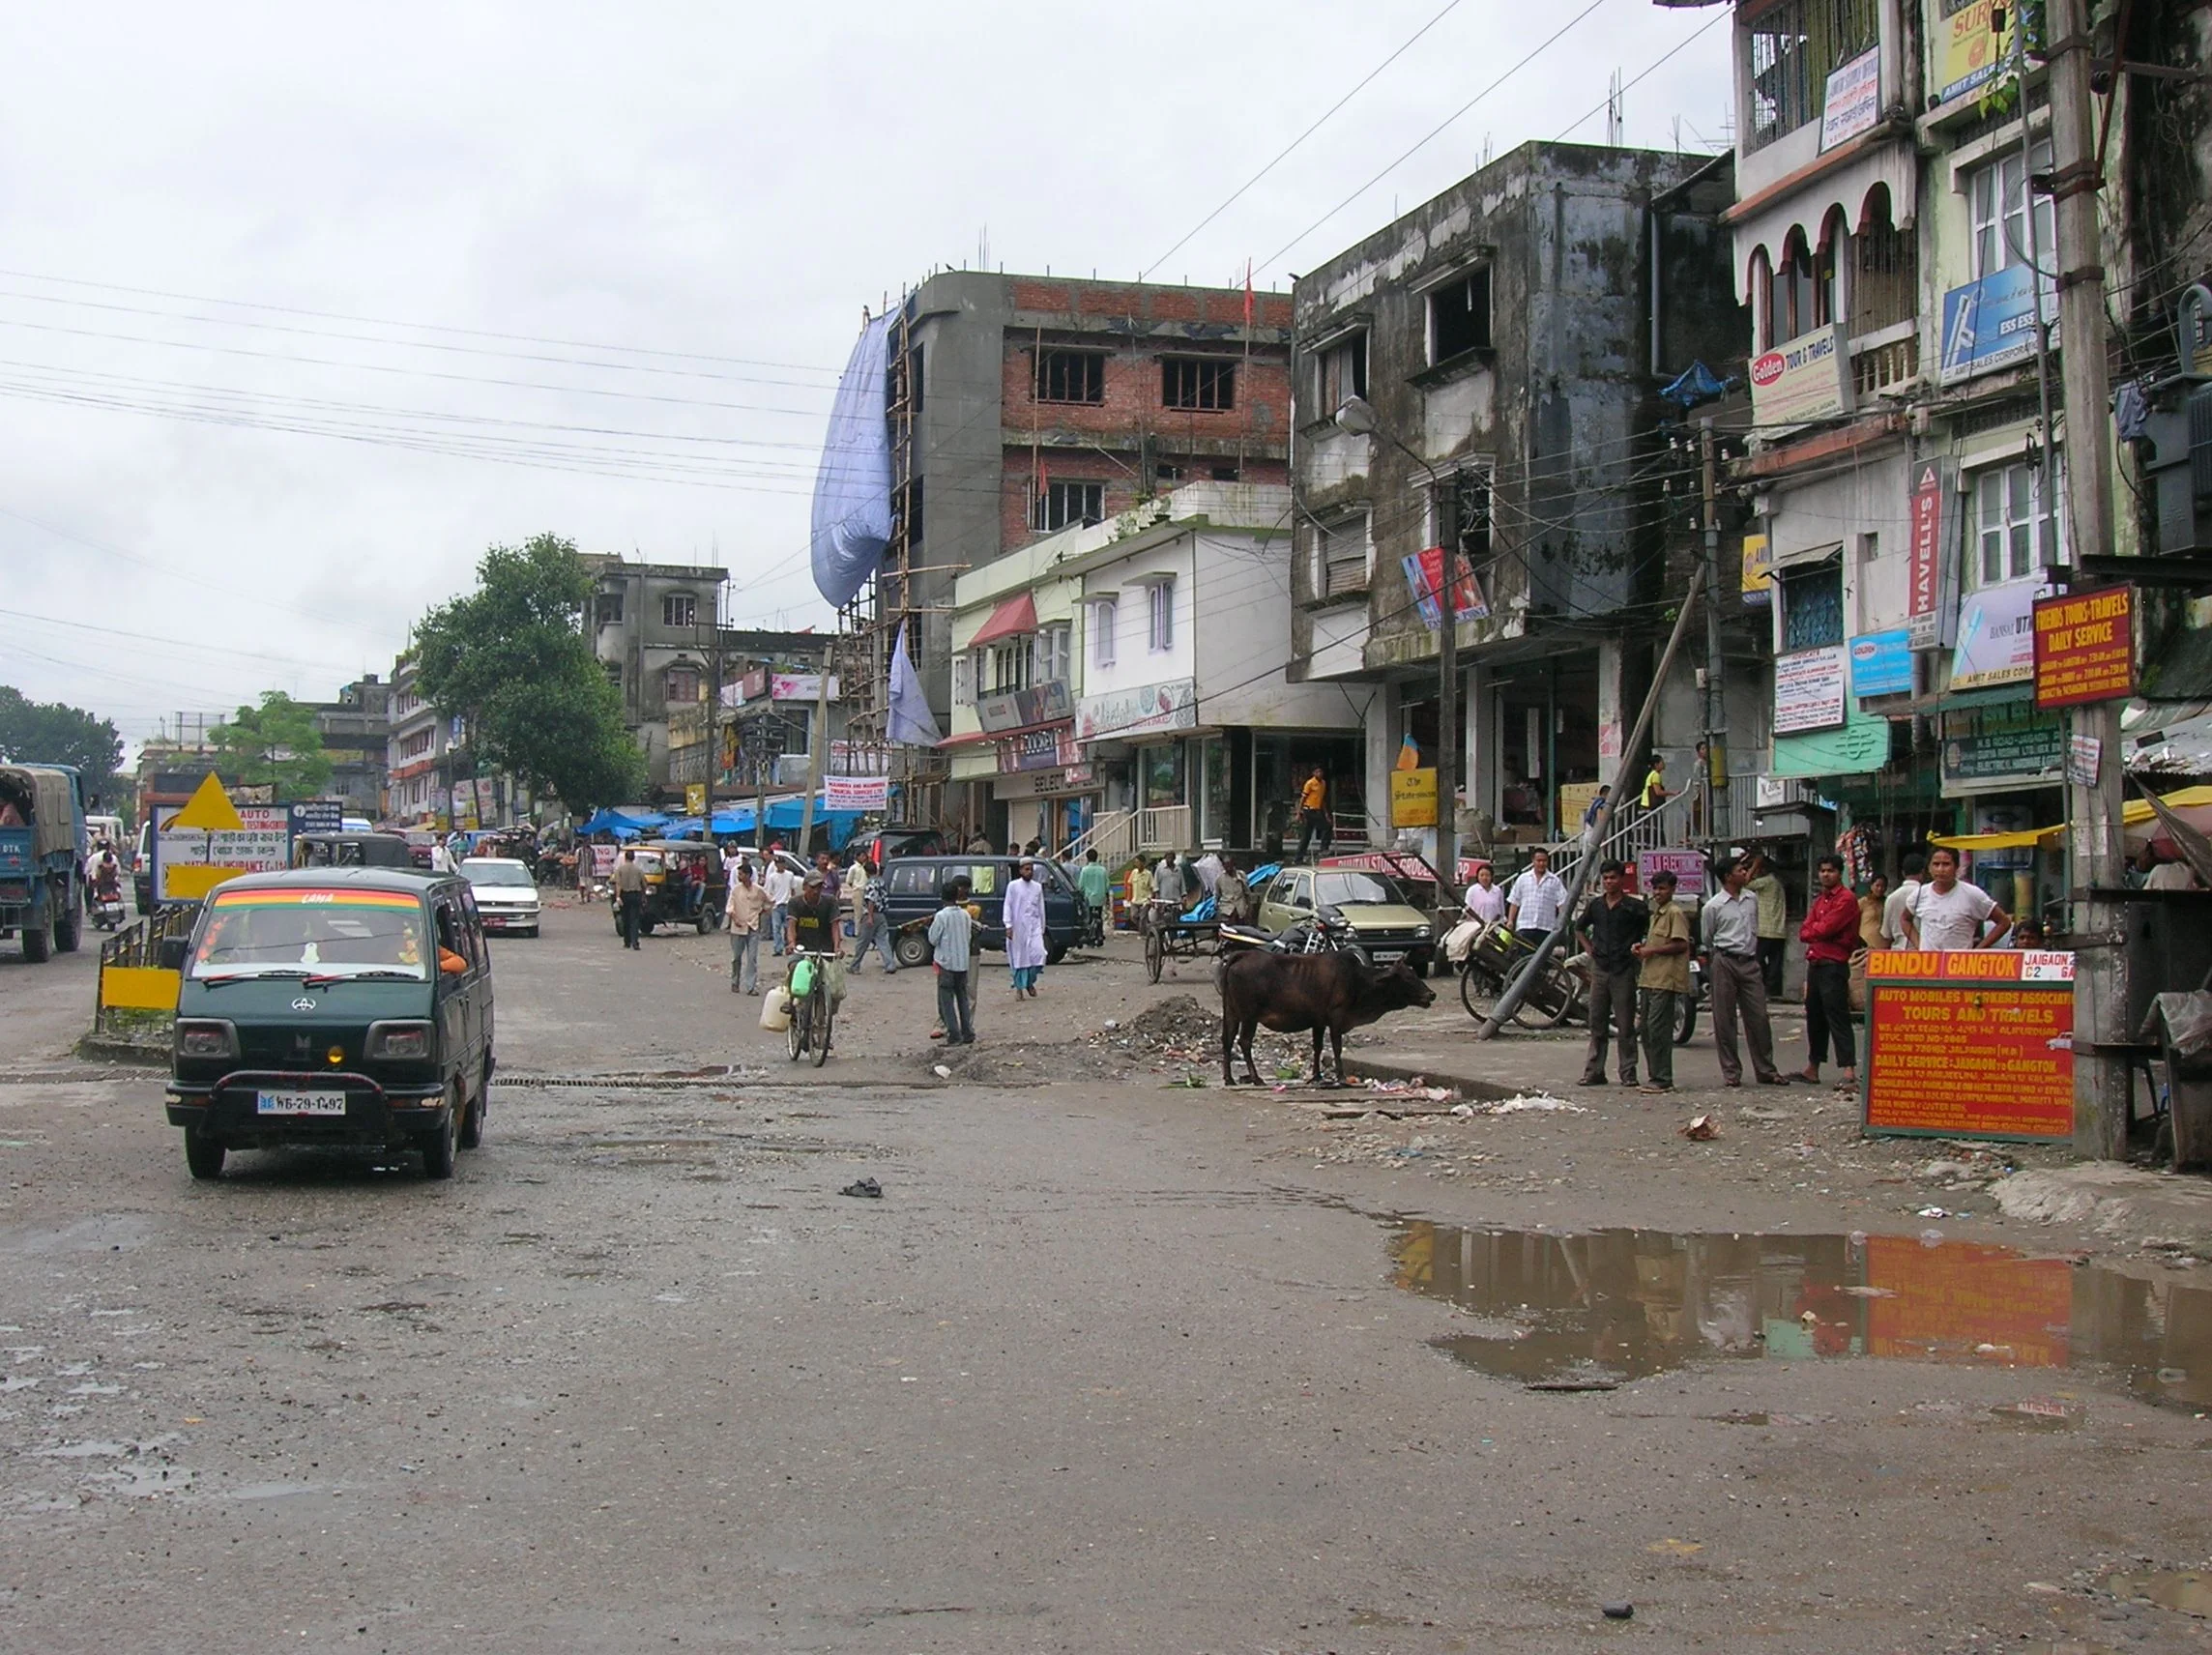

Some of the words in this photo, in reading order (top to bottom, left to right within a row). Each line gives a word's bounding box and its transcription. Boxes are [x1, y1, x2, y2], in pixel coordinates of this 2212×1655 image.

[2000, 317, 2017, 335] ESS
[1753, 358, 1783, 382] Golden
[1808, 334, 1834, 362] TRAVELS
[1972, 354, 1993, 368] SALES
[1917, 495, 1933, 613] HAVELL'S
[2036, 607, 2064, 632] FRIENDS
[2048, 629, 2073, 653] DAILY
[2075, 621, 2113, 648] SERVICE
[1988, 669, 2011, 681] SALES
[1034, 772, 1065, 793] SELECT
[240, 810, 270, 819] AUTO
[301, 893, 334, 904] LAMA
[1869, 952, 1937, 976] BINDU
[1948, 953, 2018, 977] GANGTOK
[2024, 953, 2067, 966] JAIGAON
[1878, 990, 1907, 1002] AUTO
[1909, 991, 1961, 1003] MOBILES
[1903, 1005, 1951, 1021] TOURS
[1956, 1006, 1986, 1022] AND
[1989, 1007, 2054, 1024] TRAVELS
[1876, 1055, 1906, 1067] DAILY
[2007, 1060, 2057, 1073] GANGTOK
